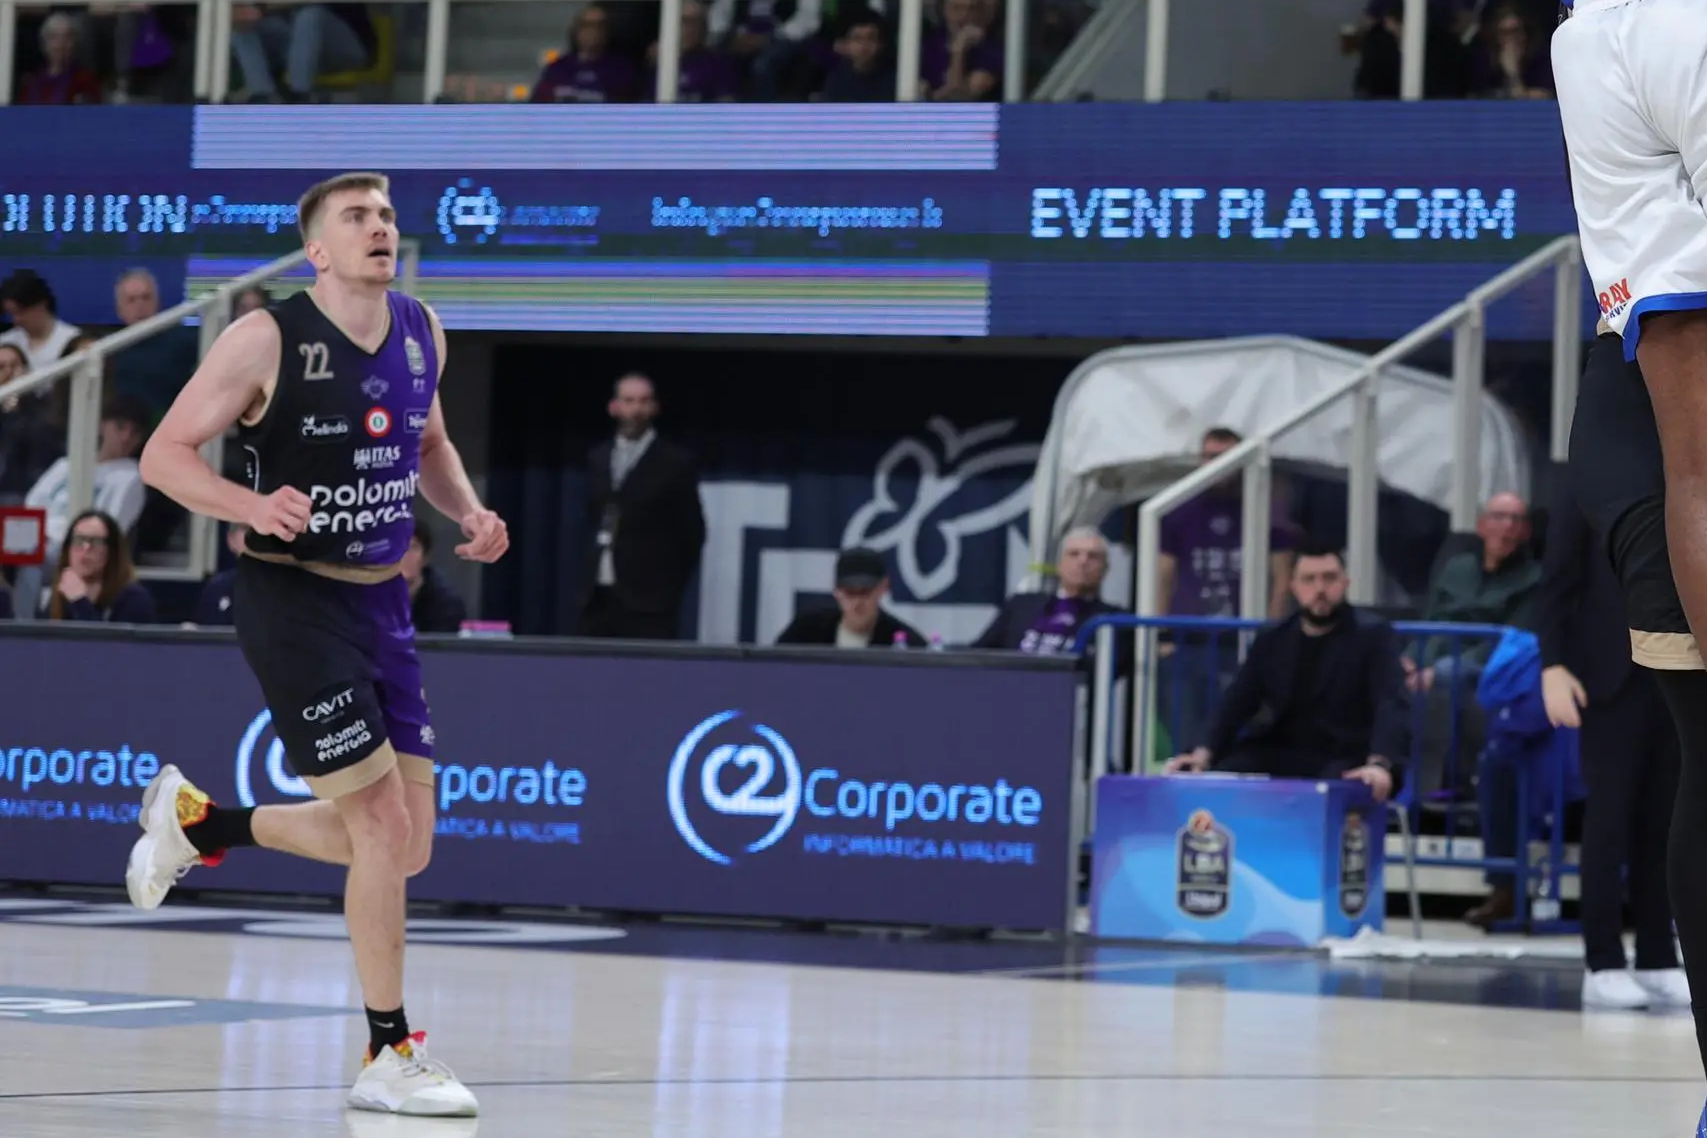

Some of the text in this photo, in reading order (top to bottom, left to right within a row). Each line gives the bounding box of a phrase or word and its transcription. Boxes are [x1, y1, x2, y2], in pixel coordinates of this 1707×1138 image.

[1031, 188, 1516, 239] EVENT PLATFORM
[299, 342, 334, 380] 22
[372, 446, 401, 462] ITAS
[302, 687, 354, 720] CAVIT
[0, 743, 159, 792] rporate
[433, 759, 587, 811] porate
[804, 768, 1042, 830] Corporate
[804, 833, 937, 860] INFORMATICA
